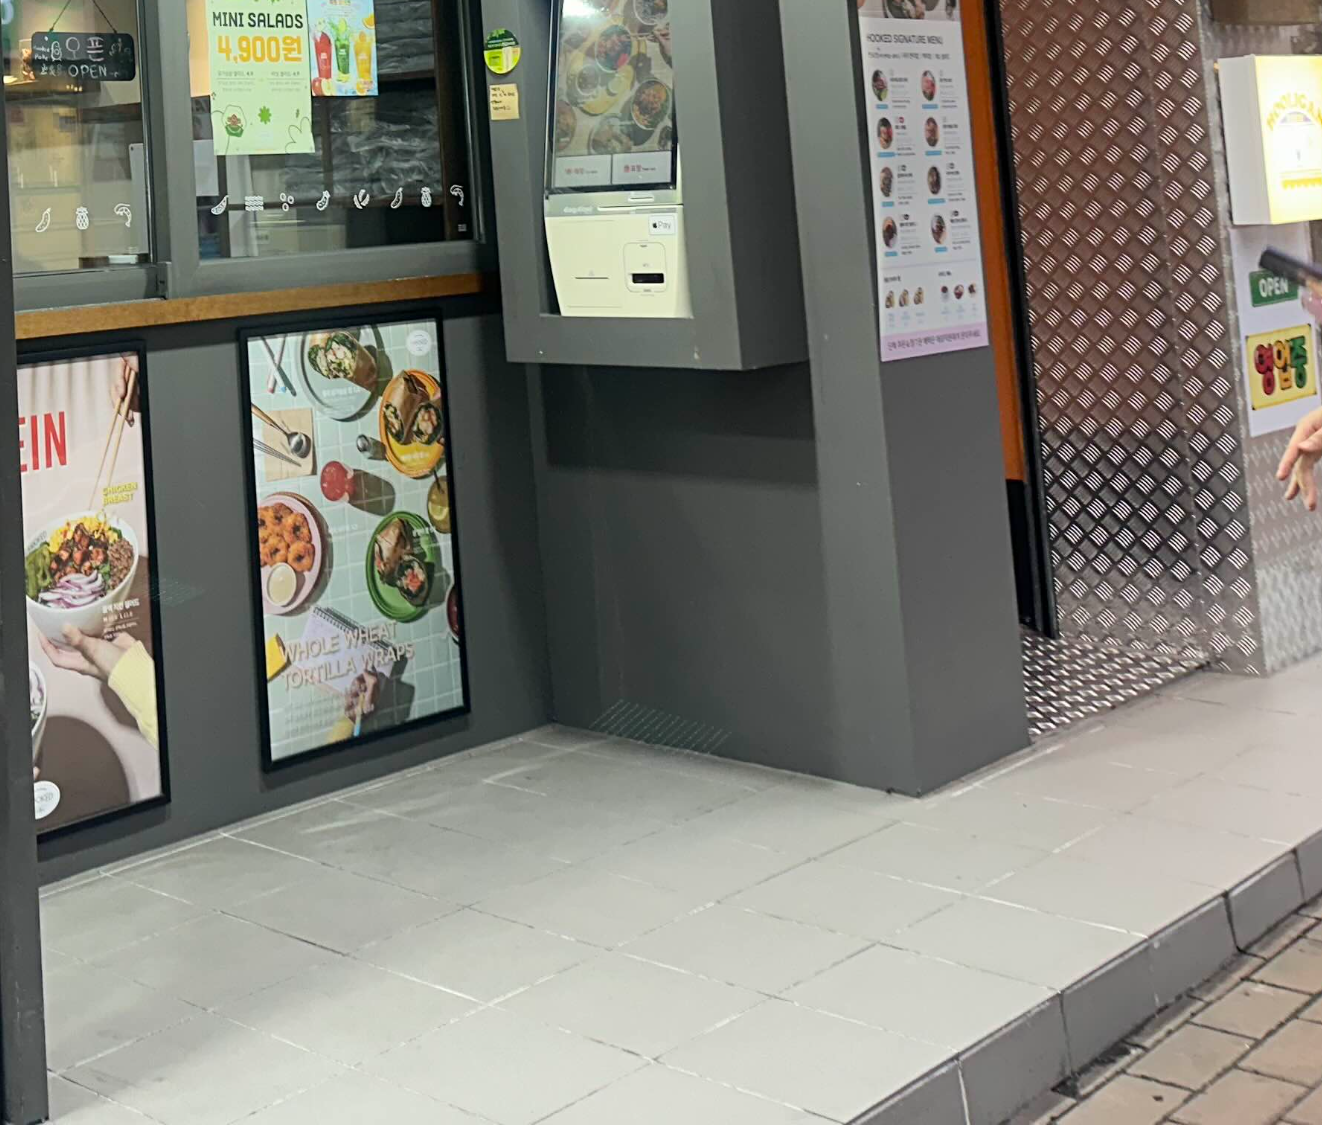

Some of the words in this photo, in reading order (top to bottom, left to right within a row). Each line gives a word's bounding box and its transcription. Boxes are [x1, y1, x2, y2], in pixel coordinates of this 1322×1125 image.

[212, 12, 244, 27] MINI
[248, 12, 303, 29] SALADS
[217, 35, 302, 64] 4,900원
[68, 64, 107, 79] OPEN
[1259, 277, 1289, 297] OPEN
[1254, 336, 1307, 395] 영업중
[284, 635, 340, 664] WHOLE
[344, 621, 397, 649] WHEAT
[282, 658, 357, 691] TORTILLA
[362, 643, 416, 671] WRAPS
